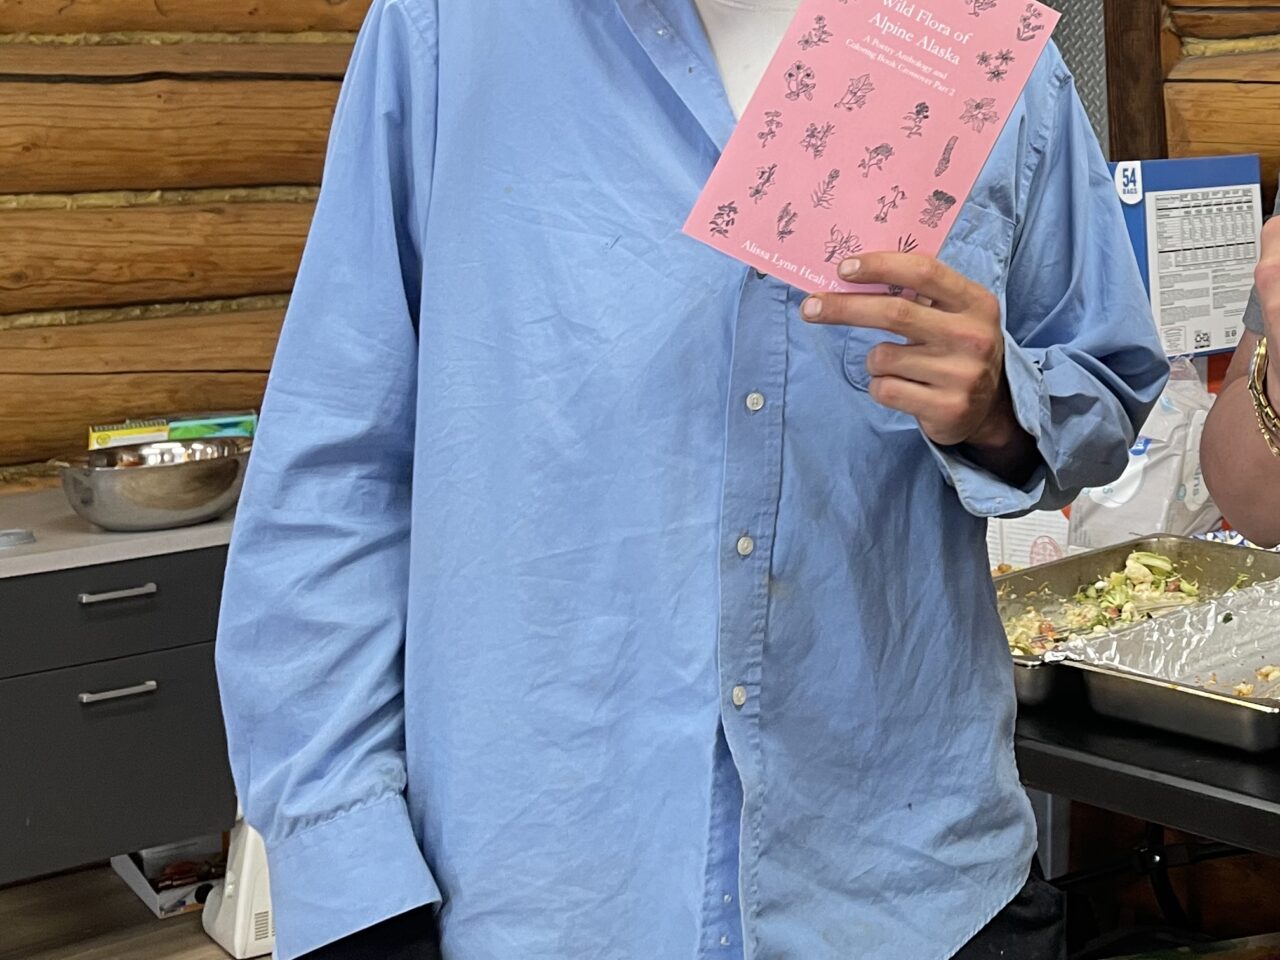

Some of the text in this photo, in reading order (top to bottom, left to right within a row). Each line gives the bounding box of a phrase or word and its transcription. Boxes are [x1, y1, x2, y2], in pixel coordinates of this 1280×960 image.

[868, 12, 961, 65] Alpine Alaska
[915, 9, 952, 36] Flora
[953, 32, 974, 45] of
[863, 35, 872, 44] A
[932, 70, 949, 81] and
[876, 53, 898, 69] Book
[932, 80, 950, 95] Part
[948, 88, 957, 97] 2
[1122, 167, 1137, 188] 54
[741, 240, 771, 260] Alissa
[772, 253, 798, 273] Lynn
[799, 265, 827, 288] Healy
